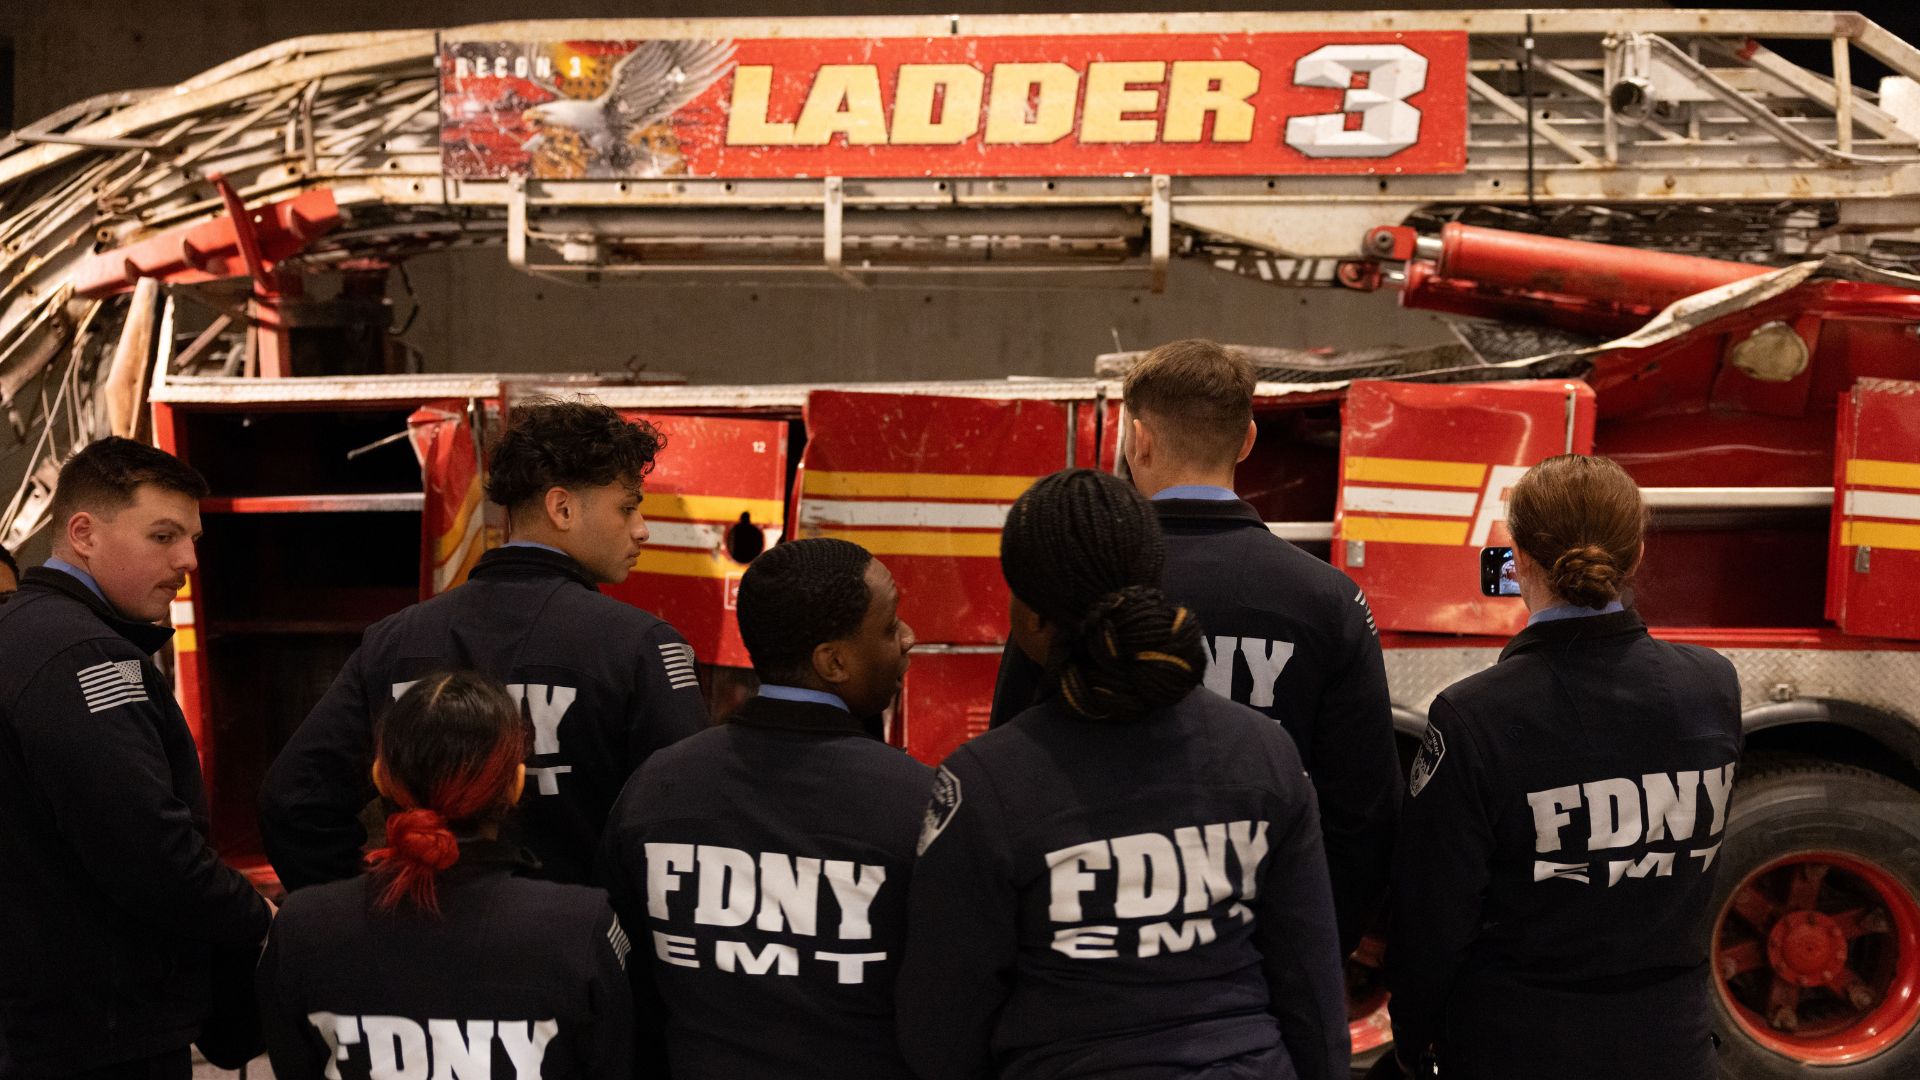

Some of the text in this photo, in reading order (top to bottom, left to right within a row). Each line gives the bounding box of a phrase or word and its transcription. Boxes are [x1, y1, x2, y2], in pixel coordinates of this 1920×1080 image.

[455, 56, 582, 79] RECON 3
[727, 44, 1429, 158] LADDER 3
[752, 440, 767, 454] 12
[1200, 635, 1295, 707] NY
[1526, 761, 1736, 853] FDNY
[644, 842, 887, 940] FDNY
[1045, 820, 1270, 922] FDNY
[652, 930, 887, 984] EMT
[307, 1011, 559, 1080] FDNY
